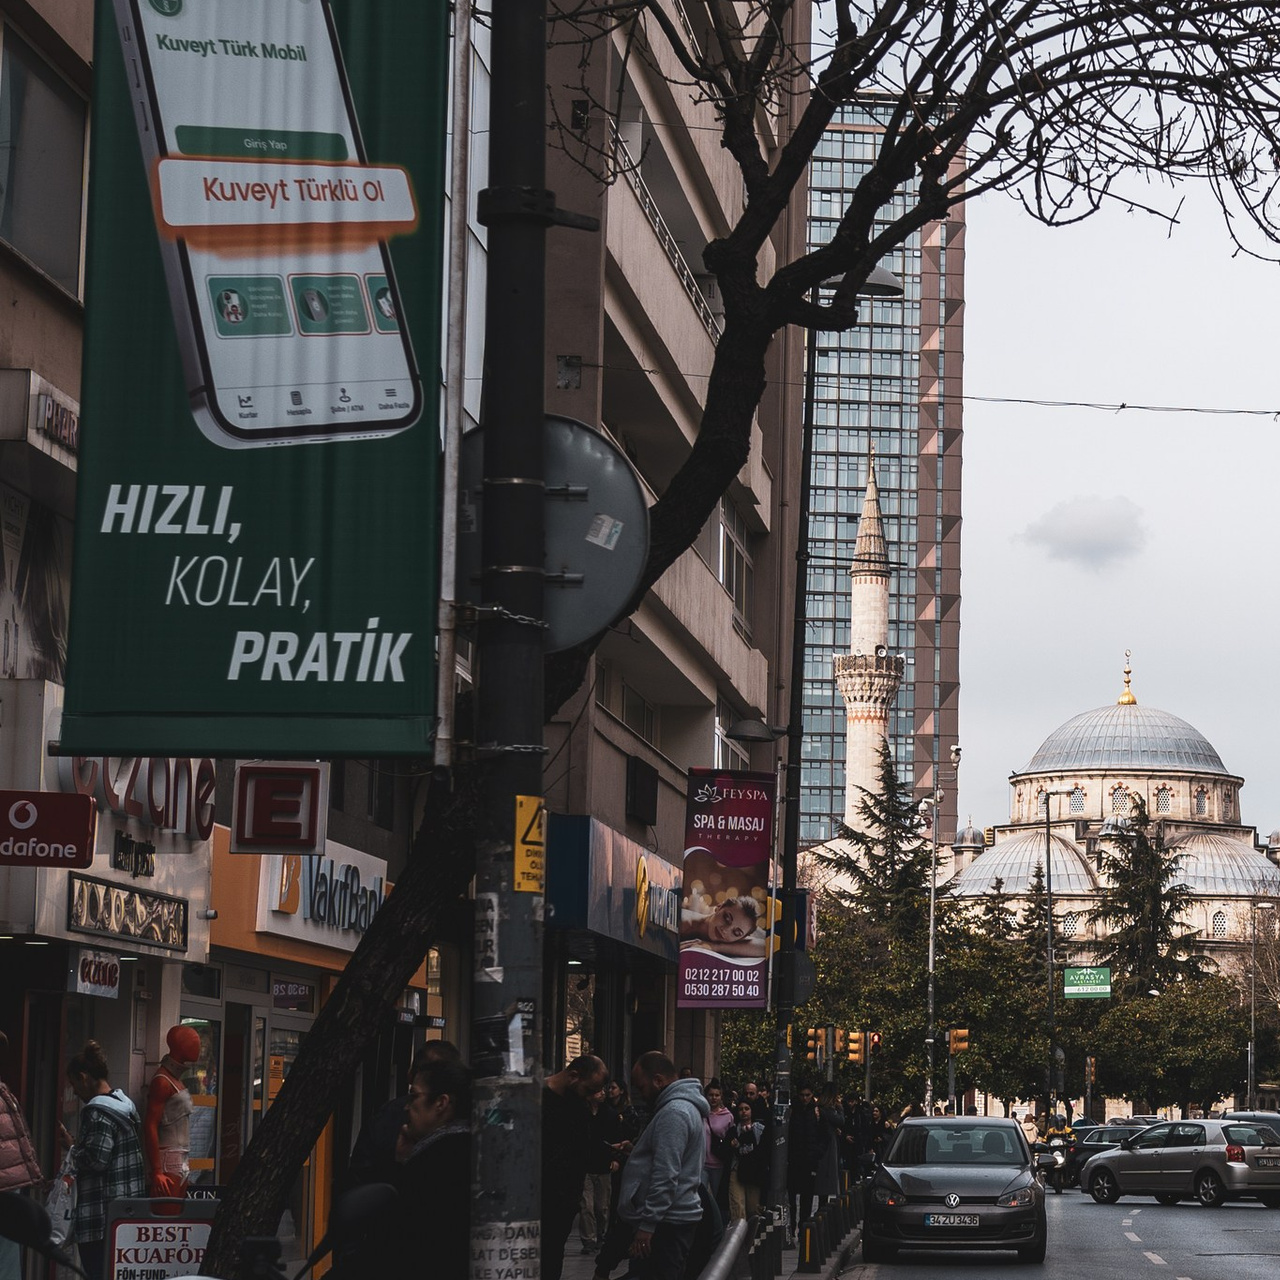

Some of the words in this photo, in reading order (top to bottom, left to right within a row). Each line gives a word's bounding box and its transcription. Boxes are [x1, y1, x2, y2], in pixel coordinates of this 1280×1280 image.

[156, 33, 216, 58] Kuveyt
[218, 37, 259, 59] Türk
[261, 41, 308, 62] Mobil
[243, 138, 267, 151] Giriş
[268, 139, 288, 152] Yap
[203, 177, 288, 209] Kuveyt
[293, 178, 360, 202] Türklü
[363, 180, 385, 202] Ol
[238, 411, 258, 419] Kurlar
[100, 483, 242, 544] HIZLI,
[165, 555, 316, 613] KOLAY,
[227, 616, 413, 682] PRATİK
[252, 777, 304, 837] E
[694, 813, 715, 830] SPA
[717, 816, 726, 830] &
[727, 816, 765, 831] MASAJ
[699, 832, 759, 842] THERAPY
[0, 835, 77, 860] dafone
[685, 967, 710, 981] 0212
[711, 968, 730, 981] 217
[732, 968, 745, 982] 00
[747, 969, 760, 982] 02
[684, 983, 709, 996] 0530
[711, 984, 730, 996] 287
[732, 985, 746, 996] 50
[747, 985, 760, 997] 40
[930, 1215, 941, 1225] 34
[942, 1215, 955, 1225] ZU
[956, 1215, 978, 1225] 3436
[136, 1226, 192, 1242] BEST
